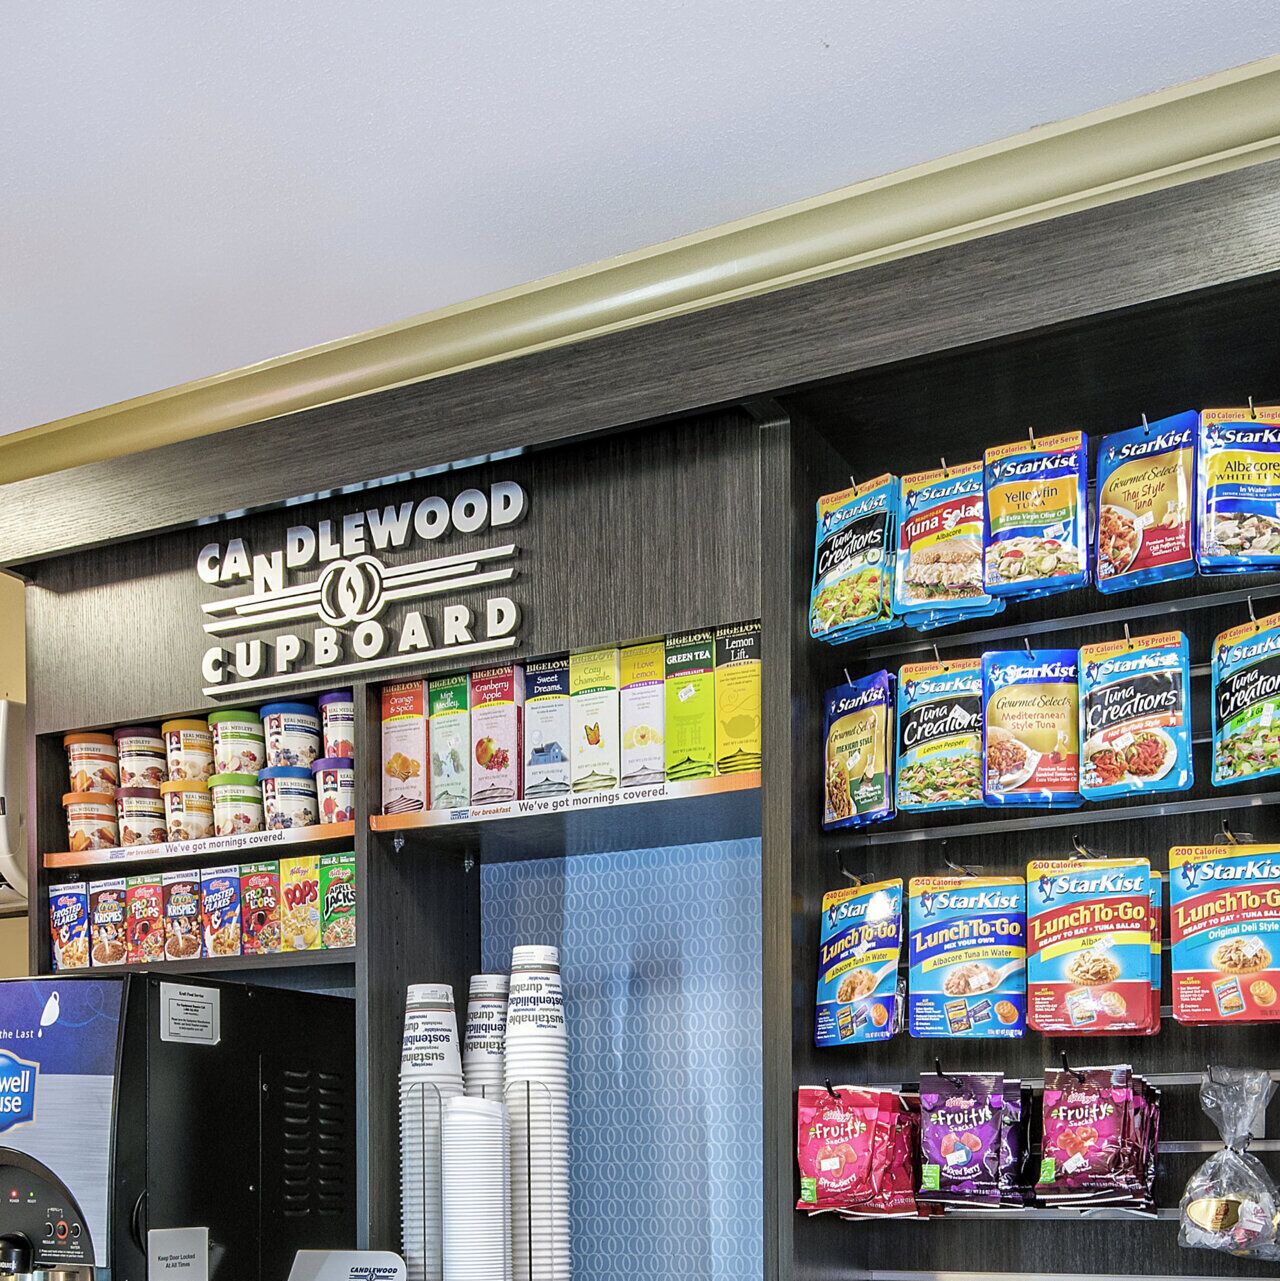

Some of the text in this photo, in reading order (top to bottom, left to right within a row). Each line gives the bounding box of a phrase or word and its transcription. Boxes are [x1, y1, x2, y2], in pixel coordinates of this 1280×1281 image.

[1118, 430, 1193, 461] StarKist
[1003, 454, 1079, 477] StarKist
[1224, 460, 1280, 472] Albacore
[1004, 485, 1058, 502] Yellowfin
[1121, 483, 1165, 502] Thai Style
[1133, 497, 1153, 509] Tuna
[197, 481, 524, 594] CANDLEWOOD
[202, 597, 517, 683] CUPBOARD
[725, 637, 754, 650] Lemon
[1095, 643, 1123, 652] Calories
[1137, 639, 1149, 648] 15g
[1150, 634, 1176, 646] Protein
[666, 650, 711, 665] GREEN TEA
[475, 680, 509, 692] Cranberry
[536, 674, 558, 684] Sweet
[482, 691, 502, 700] Apple
[1001, 711, 1066, 721] Mediterranean
[1012, 720, 1056, 729] Style Tuna
[471, 786, 668, 817] for breakfast We've got mornings covered.
[165, 831, 285, 853] We've got mornings covered.
[284, 881, 319, 910] POPS
[1183, 922, 1207, 935] READY
[1208, 918, 1218, 926] TO
[1219, 914, 1234, 923] EAT
[1242, 911, 1262, 919] TUNA
[1208, 922, 1279, 940] Original Deli Style
[0, 1029, 12, 1039] the
[16, 1029, 34, 1038] Last
